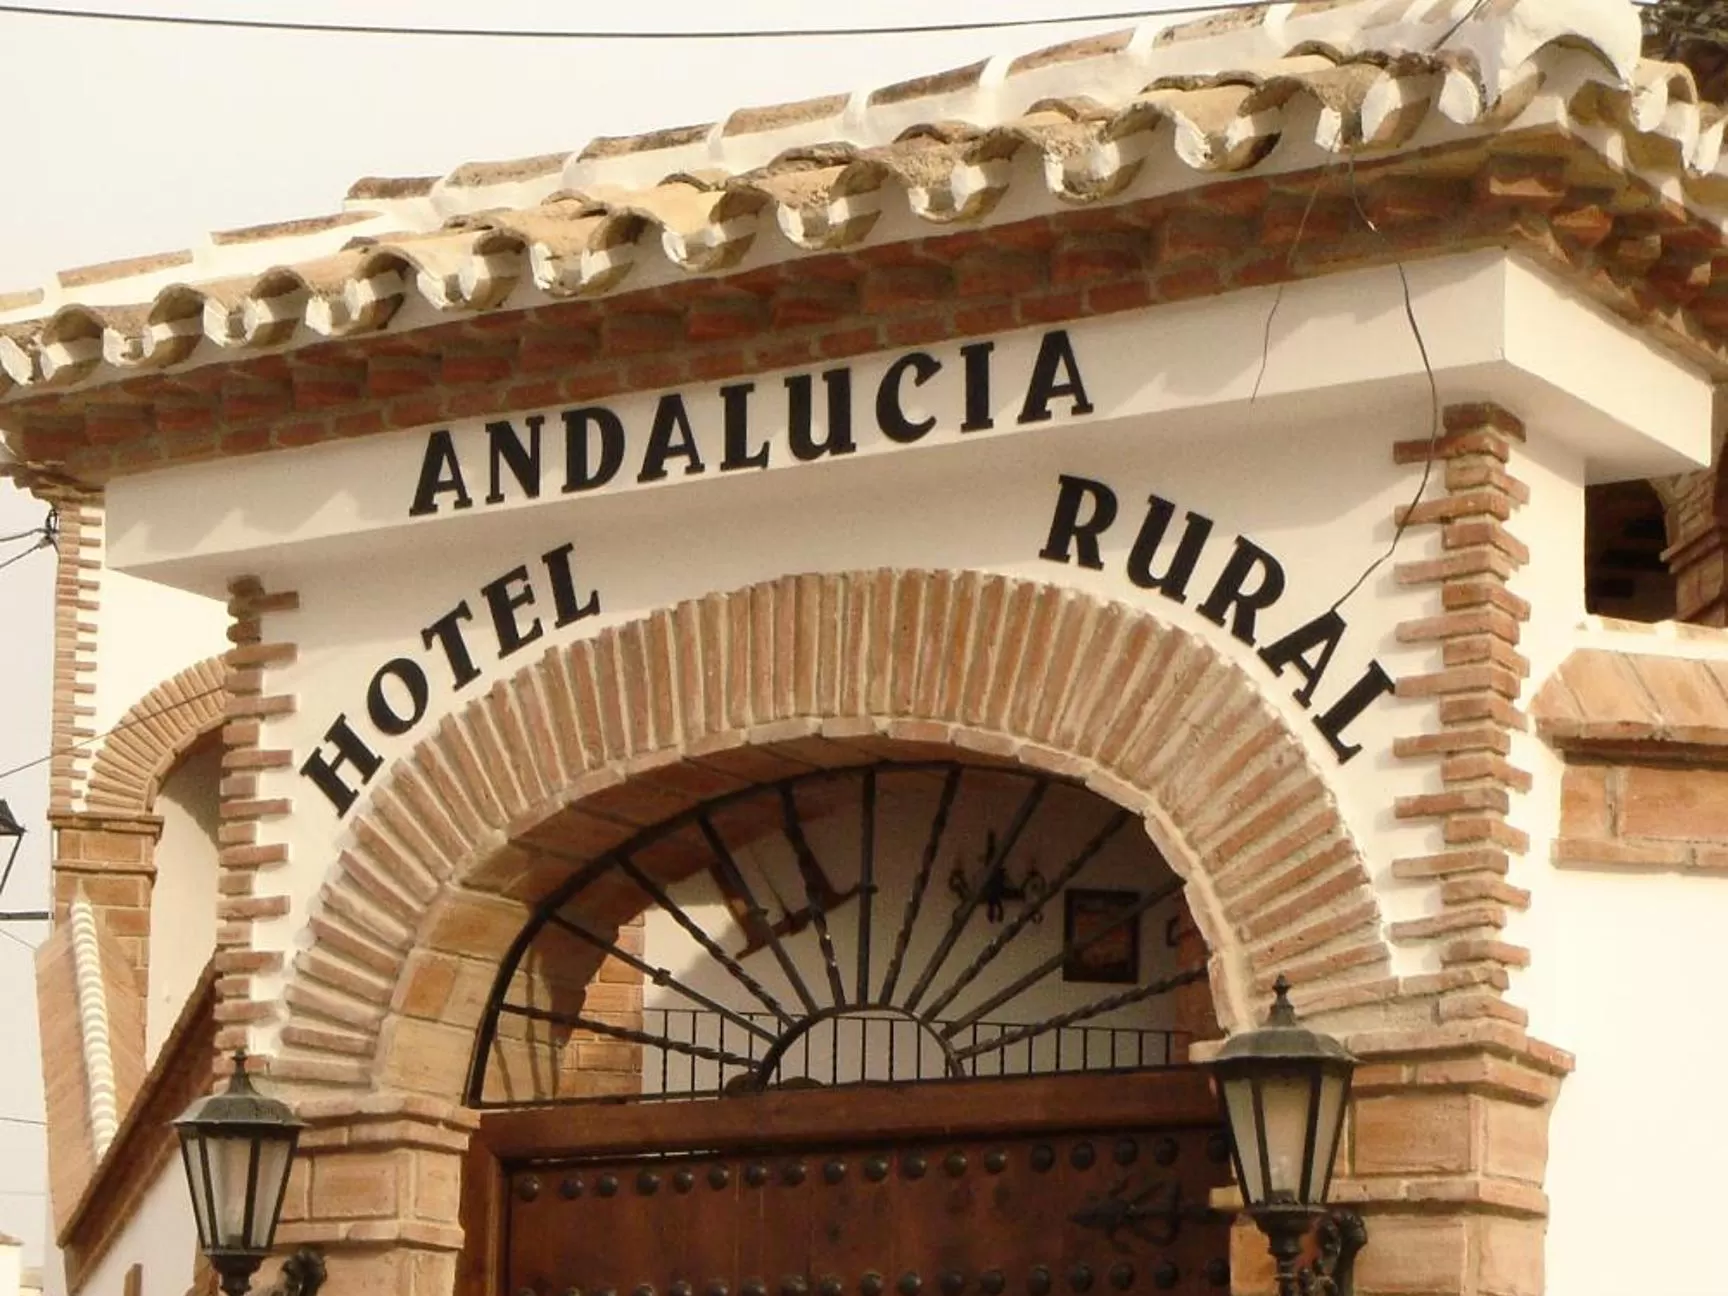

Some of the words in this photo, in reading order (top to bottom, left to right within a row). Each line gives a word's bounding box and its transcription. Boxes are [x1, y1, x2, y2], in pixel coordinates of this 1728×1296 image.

[409, 328, 1095, 517] ANDALUCIA
[300, 542, 601, 819] HOTEL
[1038, 474, 1397, 765] RURAL
